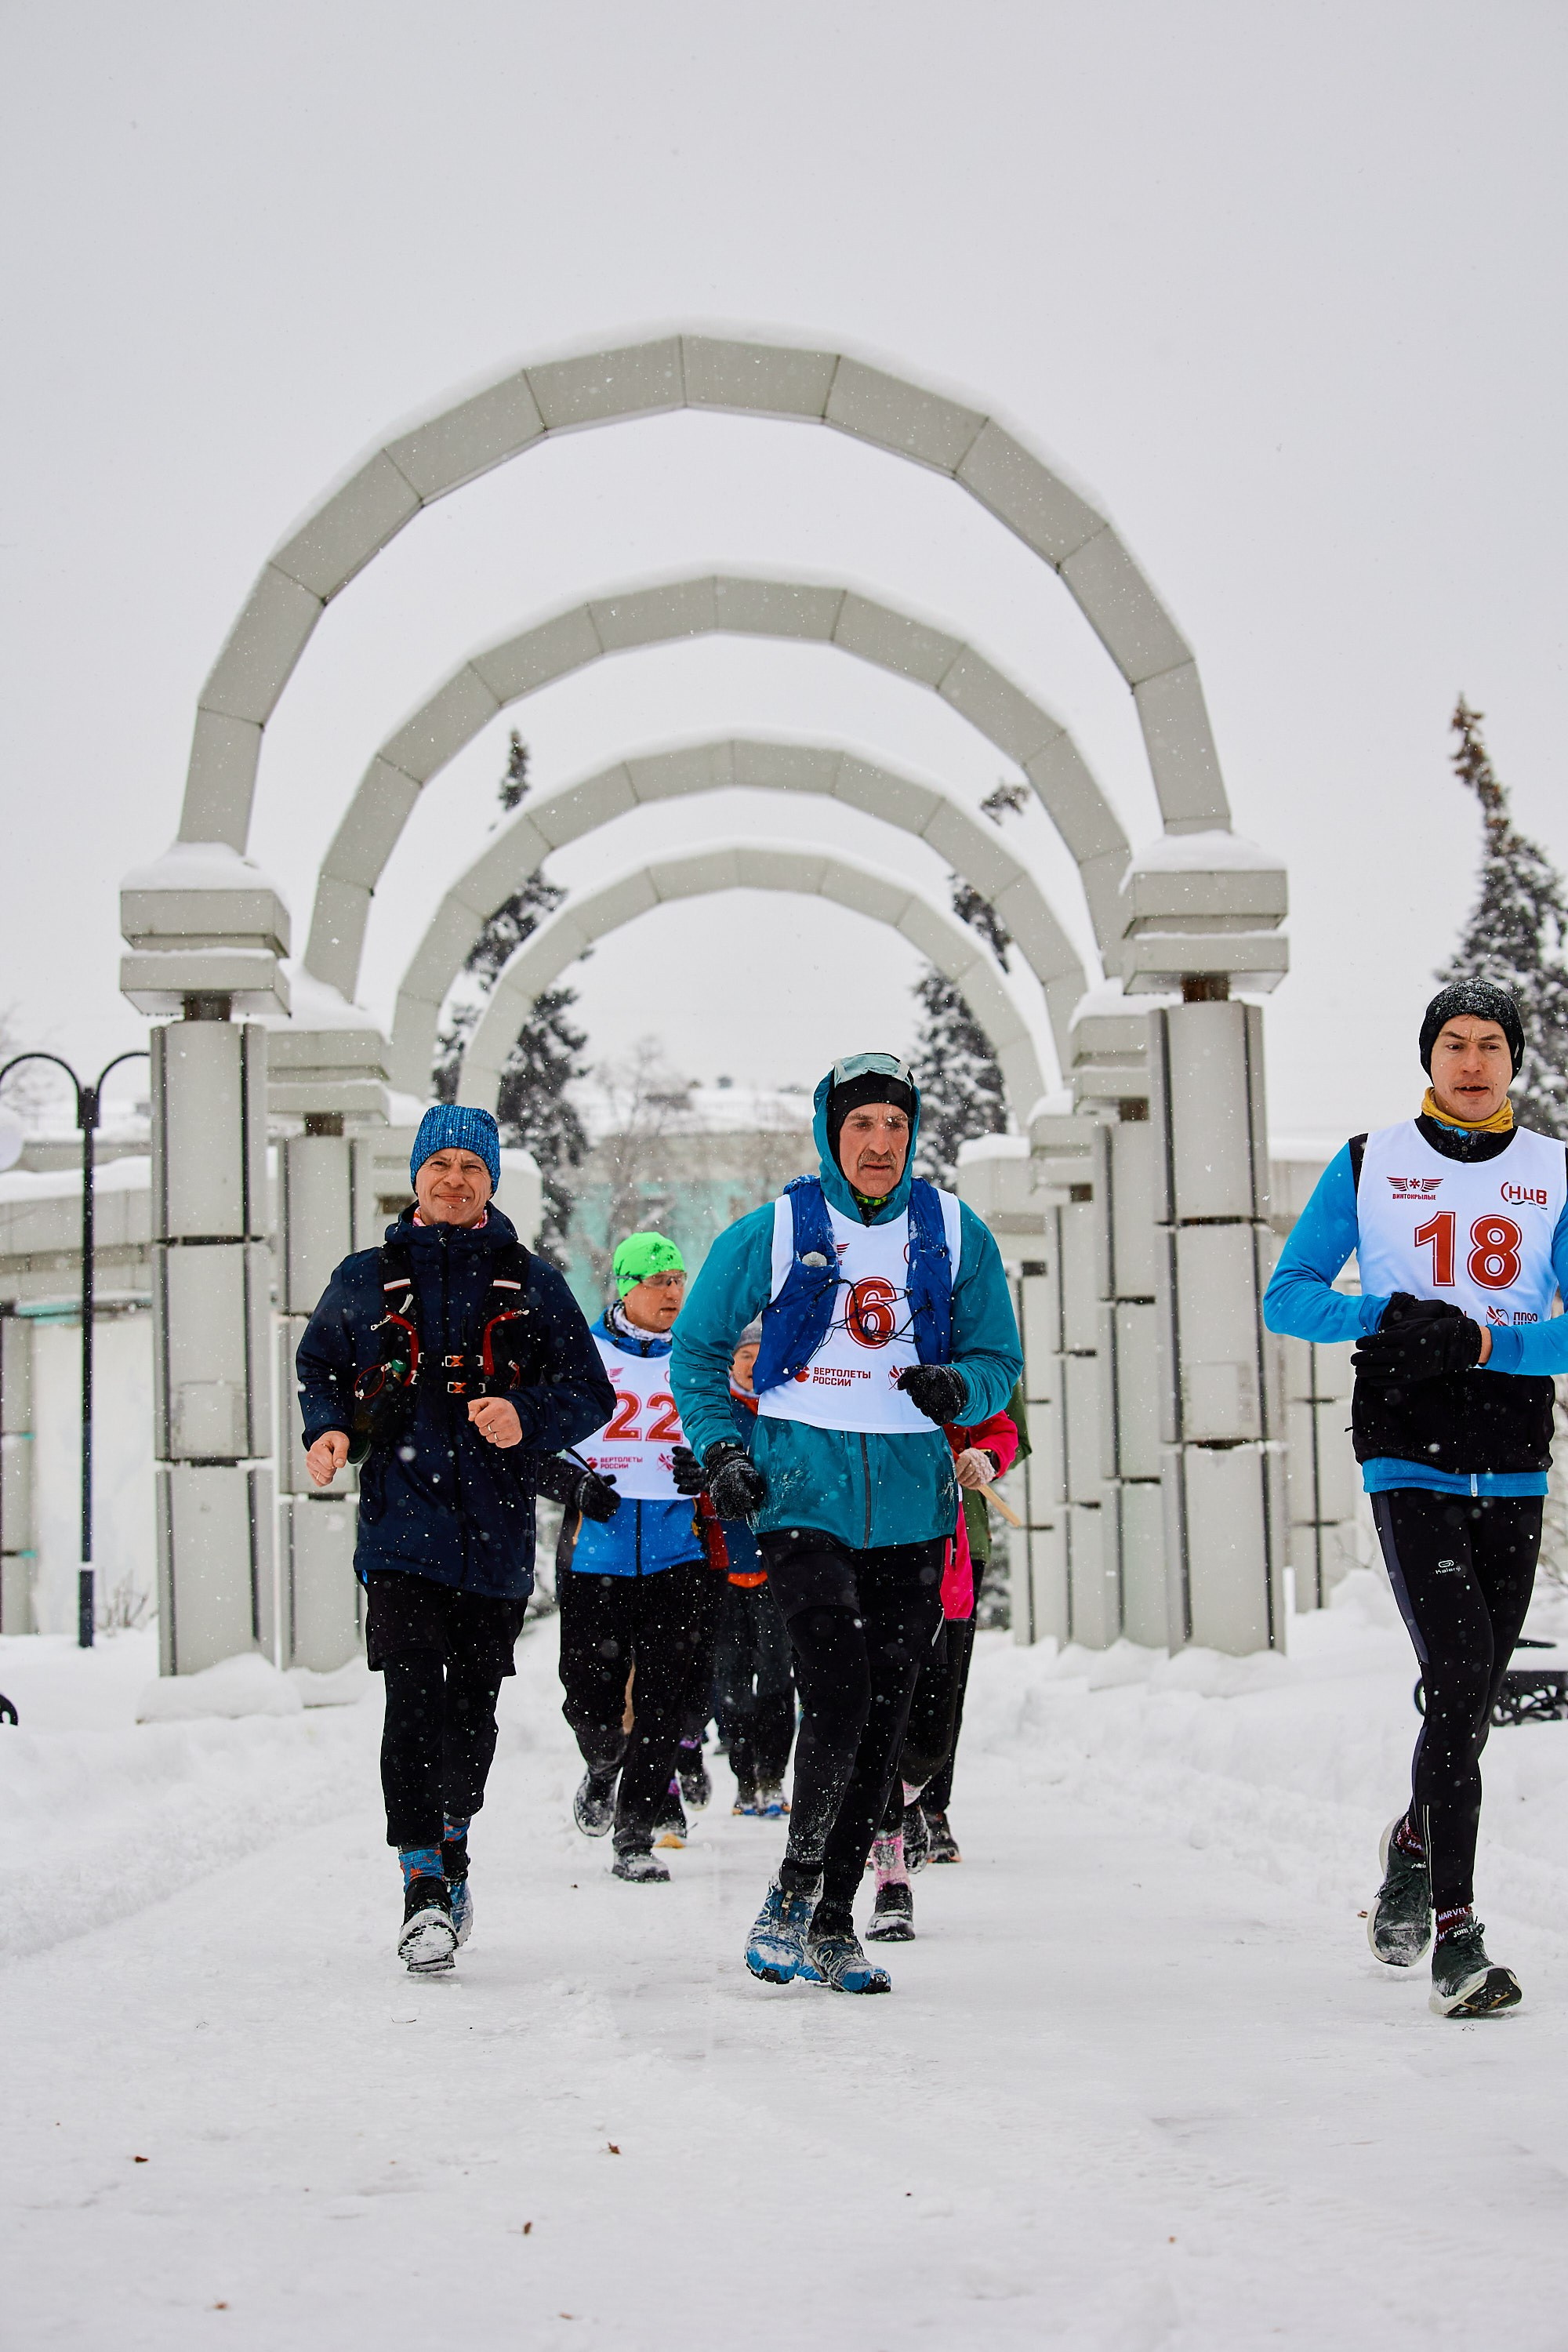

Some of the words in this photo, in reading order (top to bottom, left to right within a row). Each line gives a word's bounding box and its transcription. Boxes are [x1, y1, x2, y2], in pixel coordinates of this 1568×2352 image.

[1414, 1211, 1522, 1290] 18
[845, 1276, 897, 1349] 6
[812, 1376, 851, 1387] РОССИИ
[813, 1367, 871, 1379] ВЕРТОЛЕТЫ
[603, 1390, 684, 1444] 22
[1438, 1907, 1468, 1922] MARVEL
